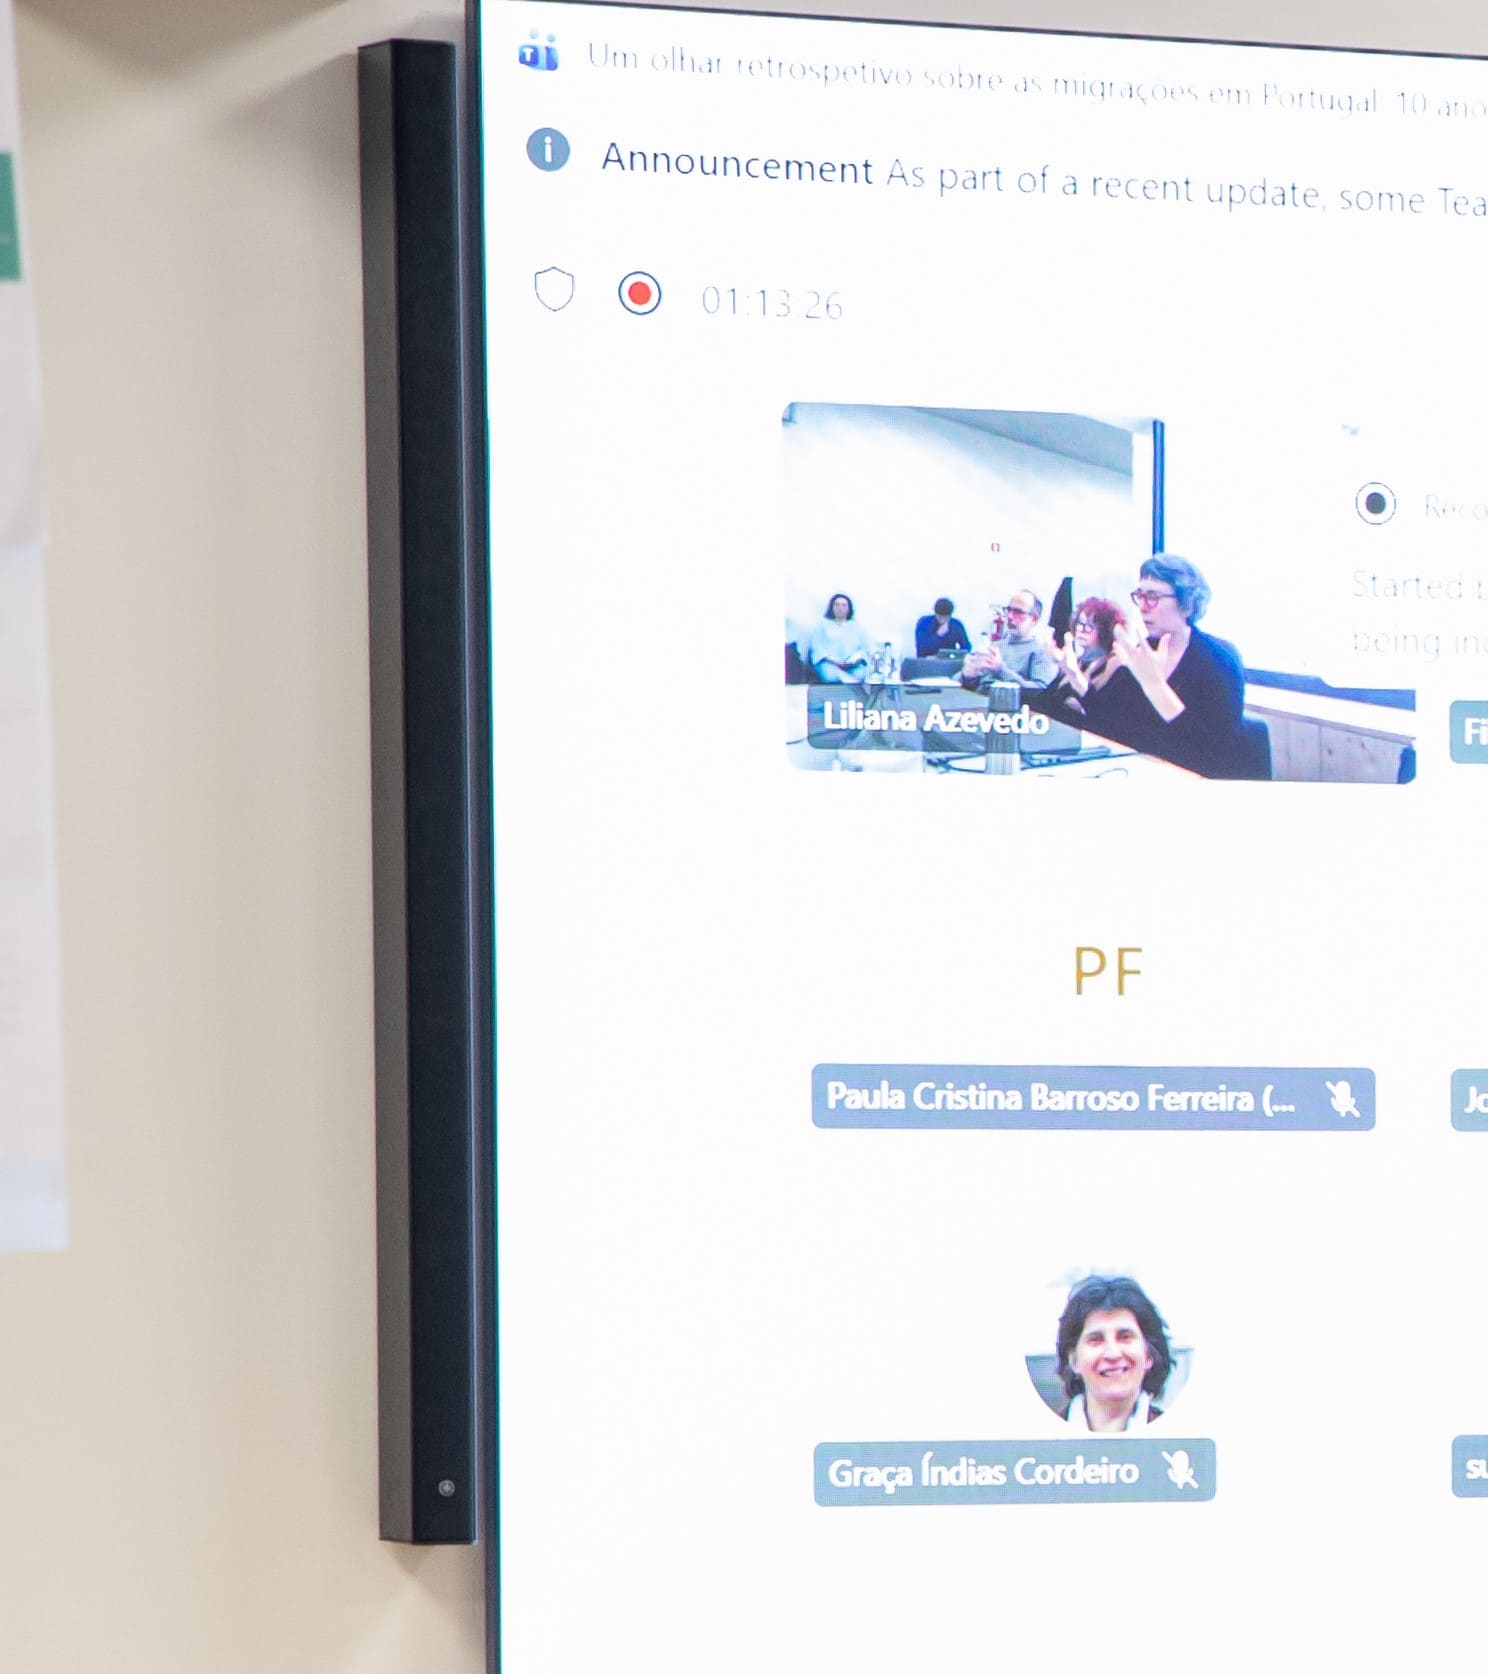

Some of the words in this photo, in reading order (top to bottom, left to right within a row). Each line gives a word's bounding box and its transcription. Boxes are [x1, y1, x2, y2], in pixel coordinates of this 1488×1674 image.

[587, 41, 639, 70] Um
[651, 44, 724, 76] olhar
[736, 49, 913, 90] retrospetivo
[923, 62, 1004, 94] sobre
[1013, 73, 1043, 95] as
[1053, 69, 1199, 109] migrações
[1208, 83, 1252, 106] em
[1397, 90, 1428, 114] 10
[602, 141, 874, 187] Announcement
[886, 157, 925, 188] As
[938, 164, 1005, 198] part
[1017, 165, 1051, 195] of
[1062, 174, 1079, 197] a
[1090, 171, 1194, 204] recent
[1206, 176, 1326, 214] update,
[1339, 187, 1426, 214] some
[701, 285, 844, 321] 01:13:26
[823, 701, 917, 733] Liliana
[924, 703, 1050, 736] Azevedo
[1075, 945, 1144, 997] PF
[826, 1081, 906, 1113] Paula
[912, 1082, 1024, 1113] Cristina
[1029, 1084, 1139, 1115] Barroso
[1148, 1084, 1254, 1115] Ferreira
[828, 1459, 914, 1495] Graça
[920, 1450, 1007, 1489] Índias
[1014, 1456, 1139, 1487] Cordeiro
